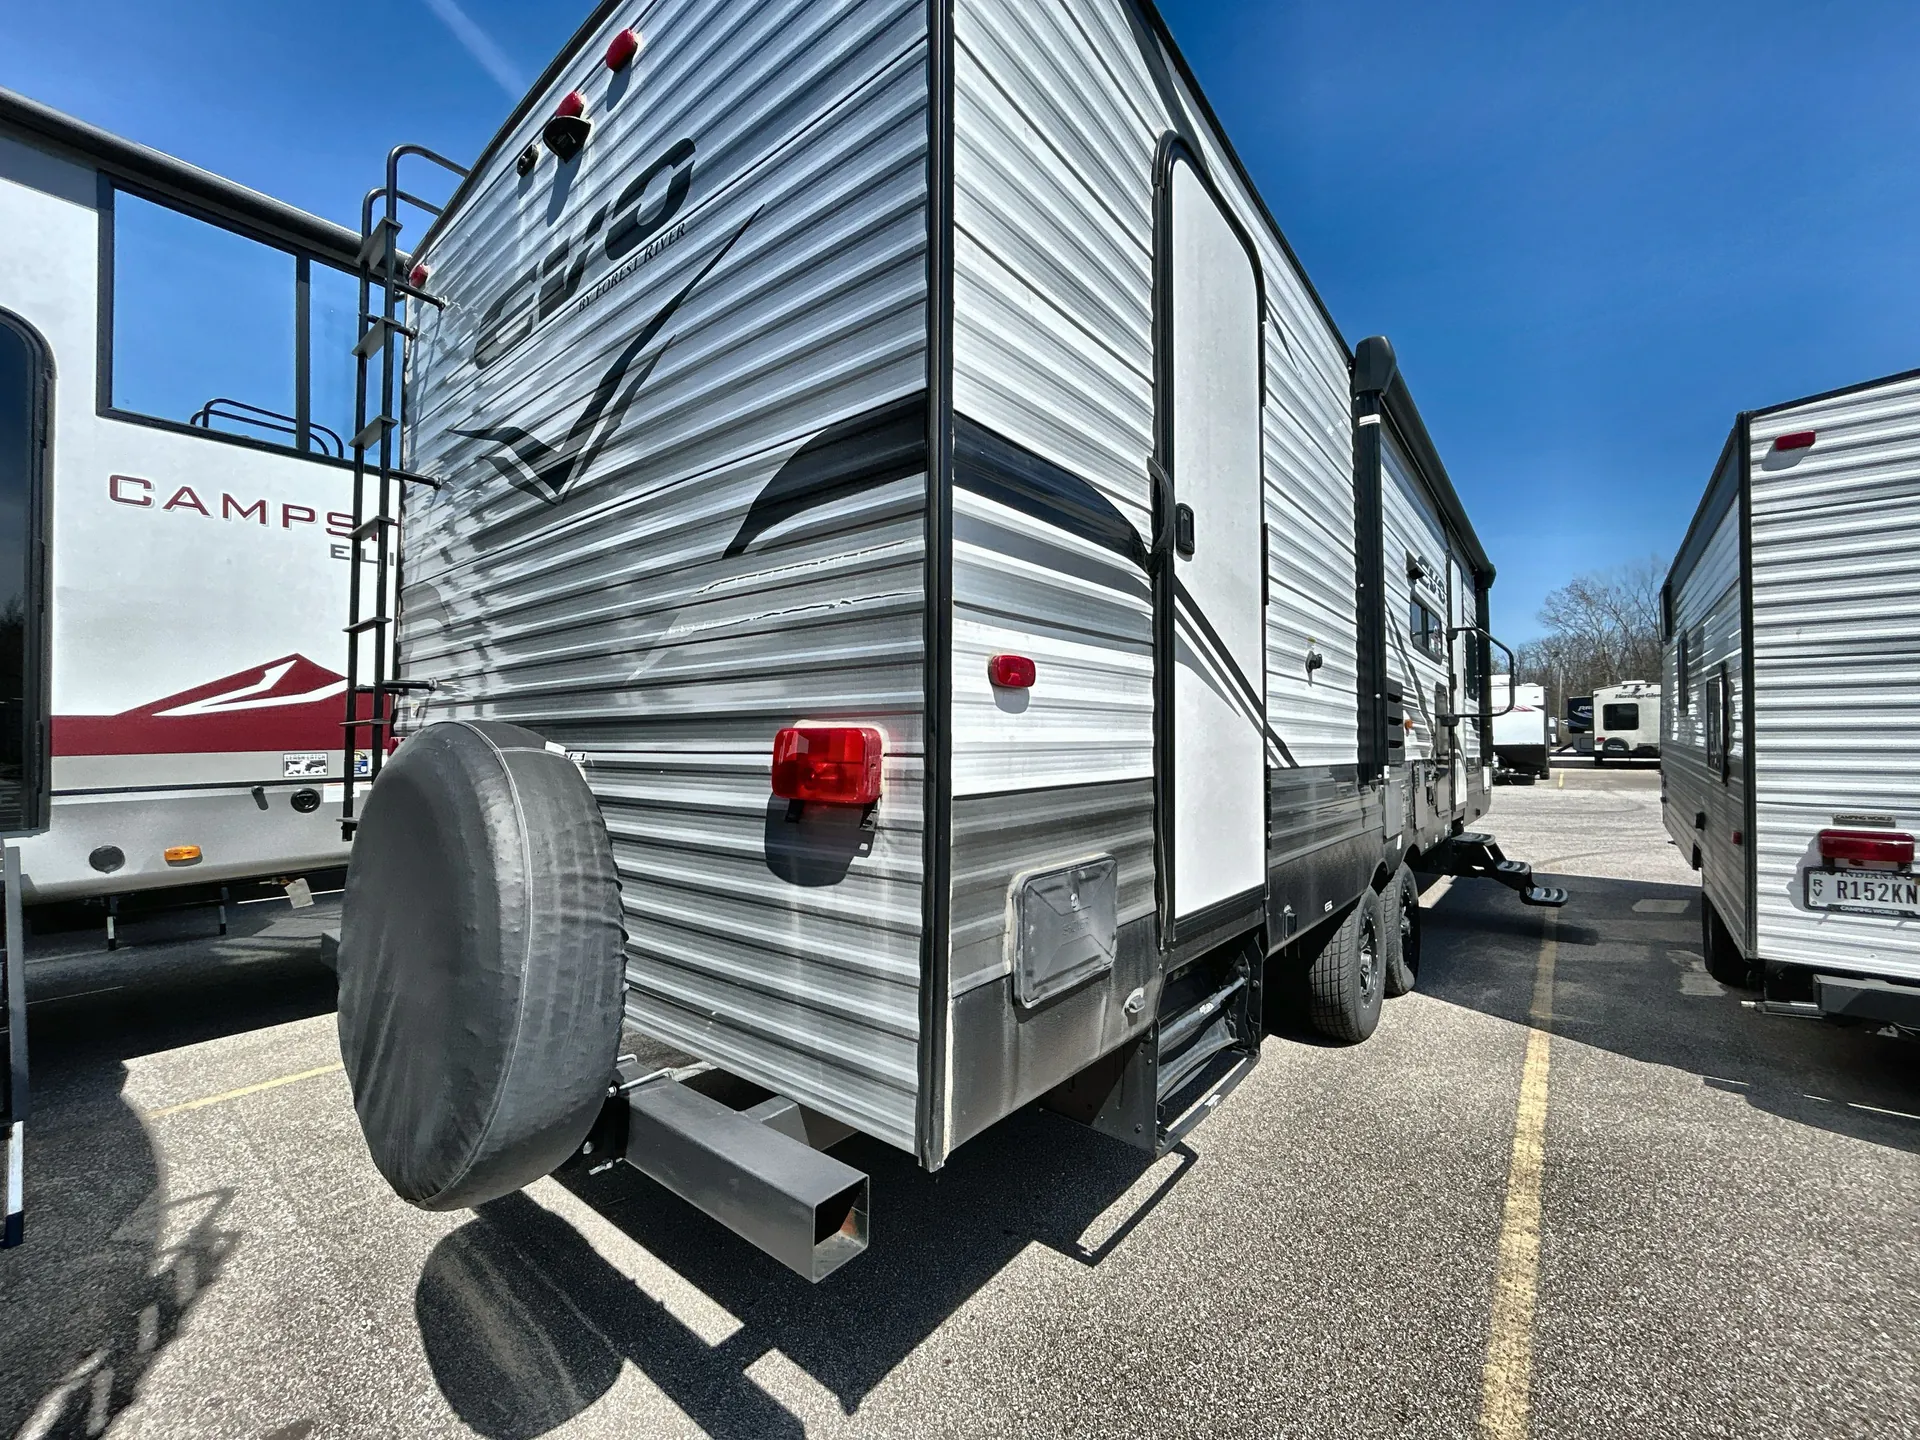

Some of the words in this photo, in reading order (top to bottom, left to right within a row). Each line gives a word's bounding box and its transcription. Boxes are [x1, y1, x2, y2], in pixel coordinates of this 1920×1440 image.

[578, 295, 591, 312] BY
[595, 256, 641, 300] FOREST
[644, 222, 686, 264] RIVER
[109, 474, 399, 542] CAMPS
[1836, 880, 1918, 904] R152KN
[1840, 871, 1899, 881] INDIANA
